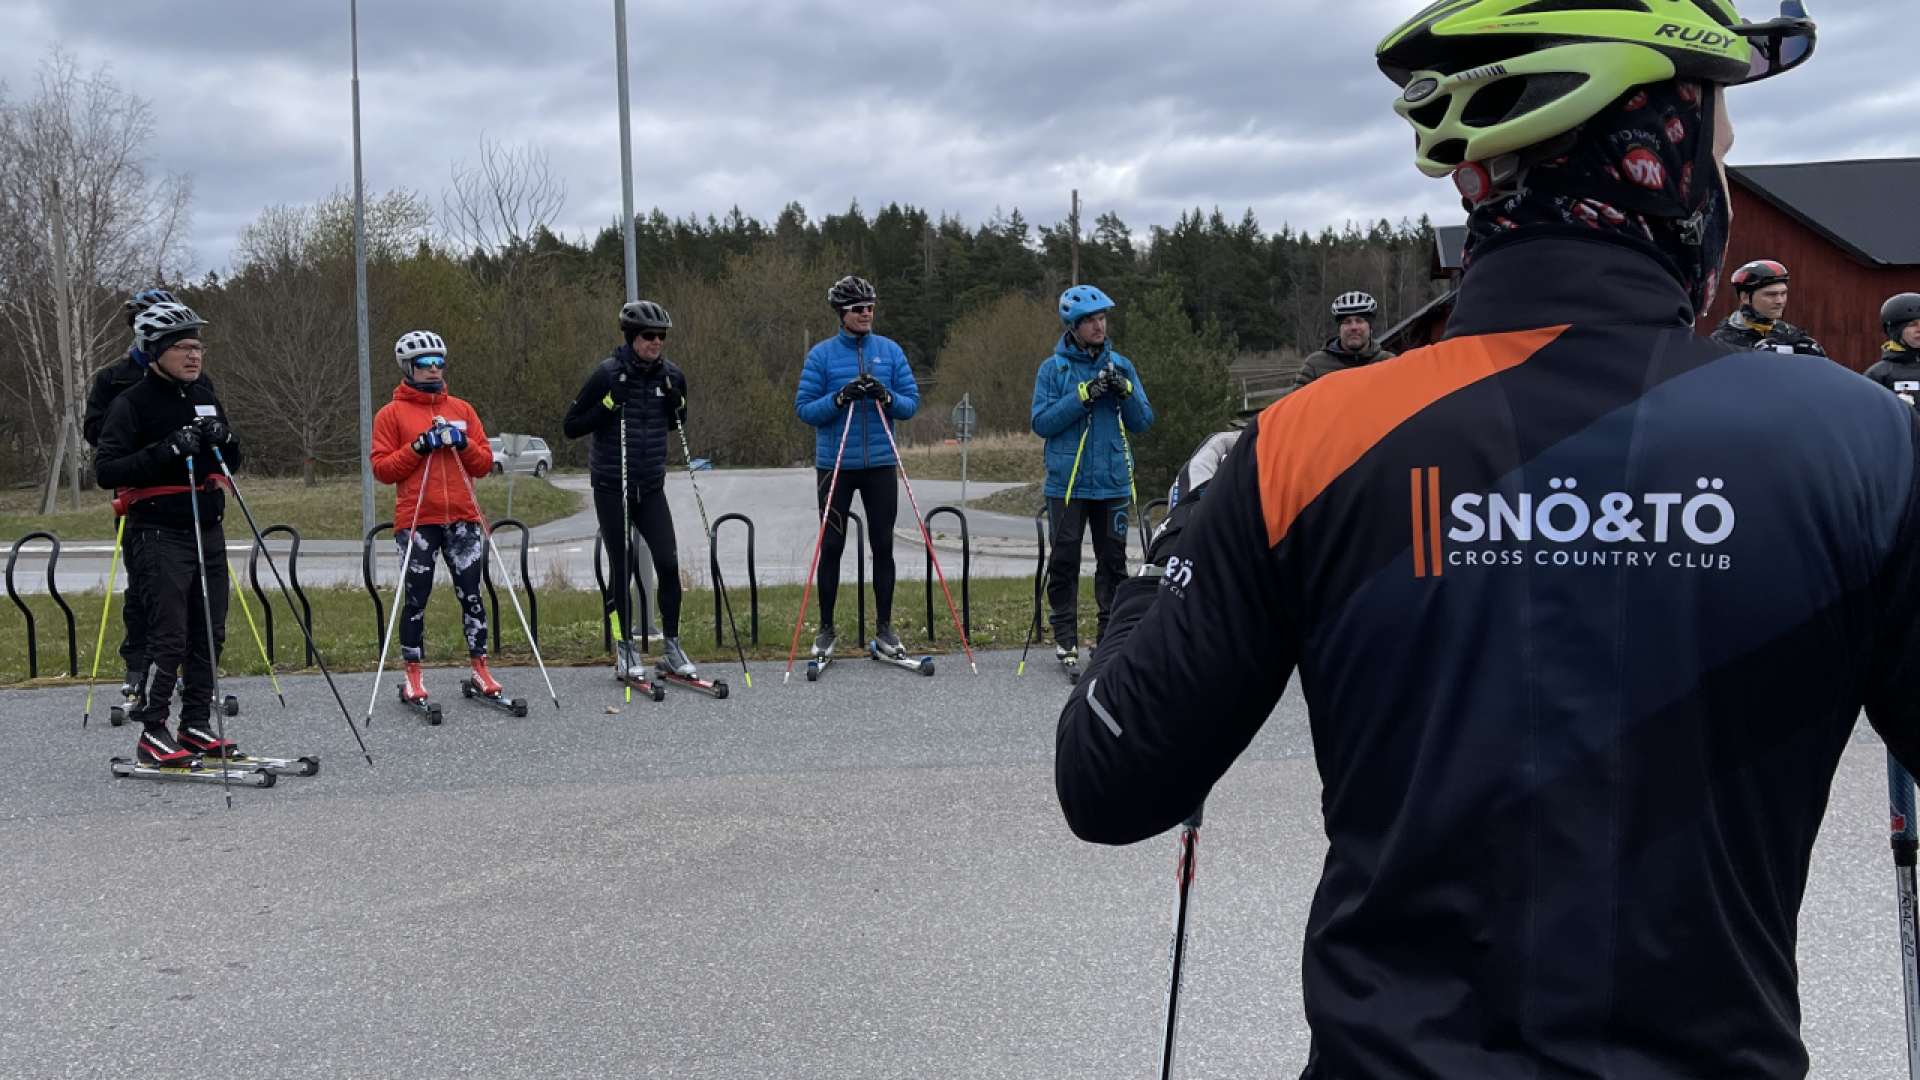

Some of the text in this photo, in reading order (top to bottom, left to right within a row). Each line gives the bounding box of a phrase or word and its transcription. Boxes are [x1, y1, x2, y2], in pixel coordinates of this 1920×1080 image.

[1654, 23, 1737, 48] RUDY
[1448, 476, 1735, 545] SNÖ&TÖ
[1448, 550, 1731, 570] CROSS COUNTRY CLUB
